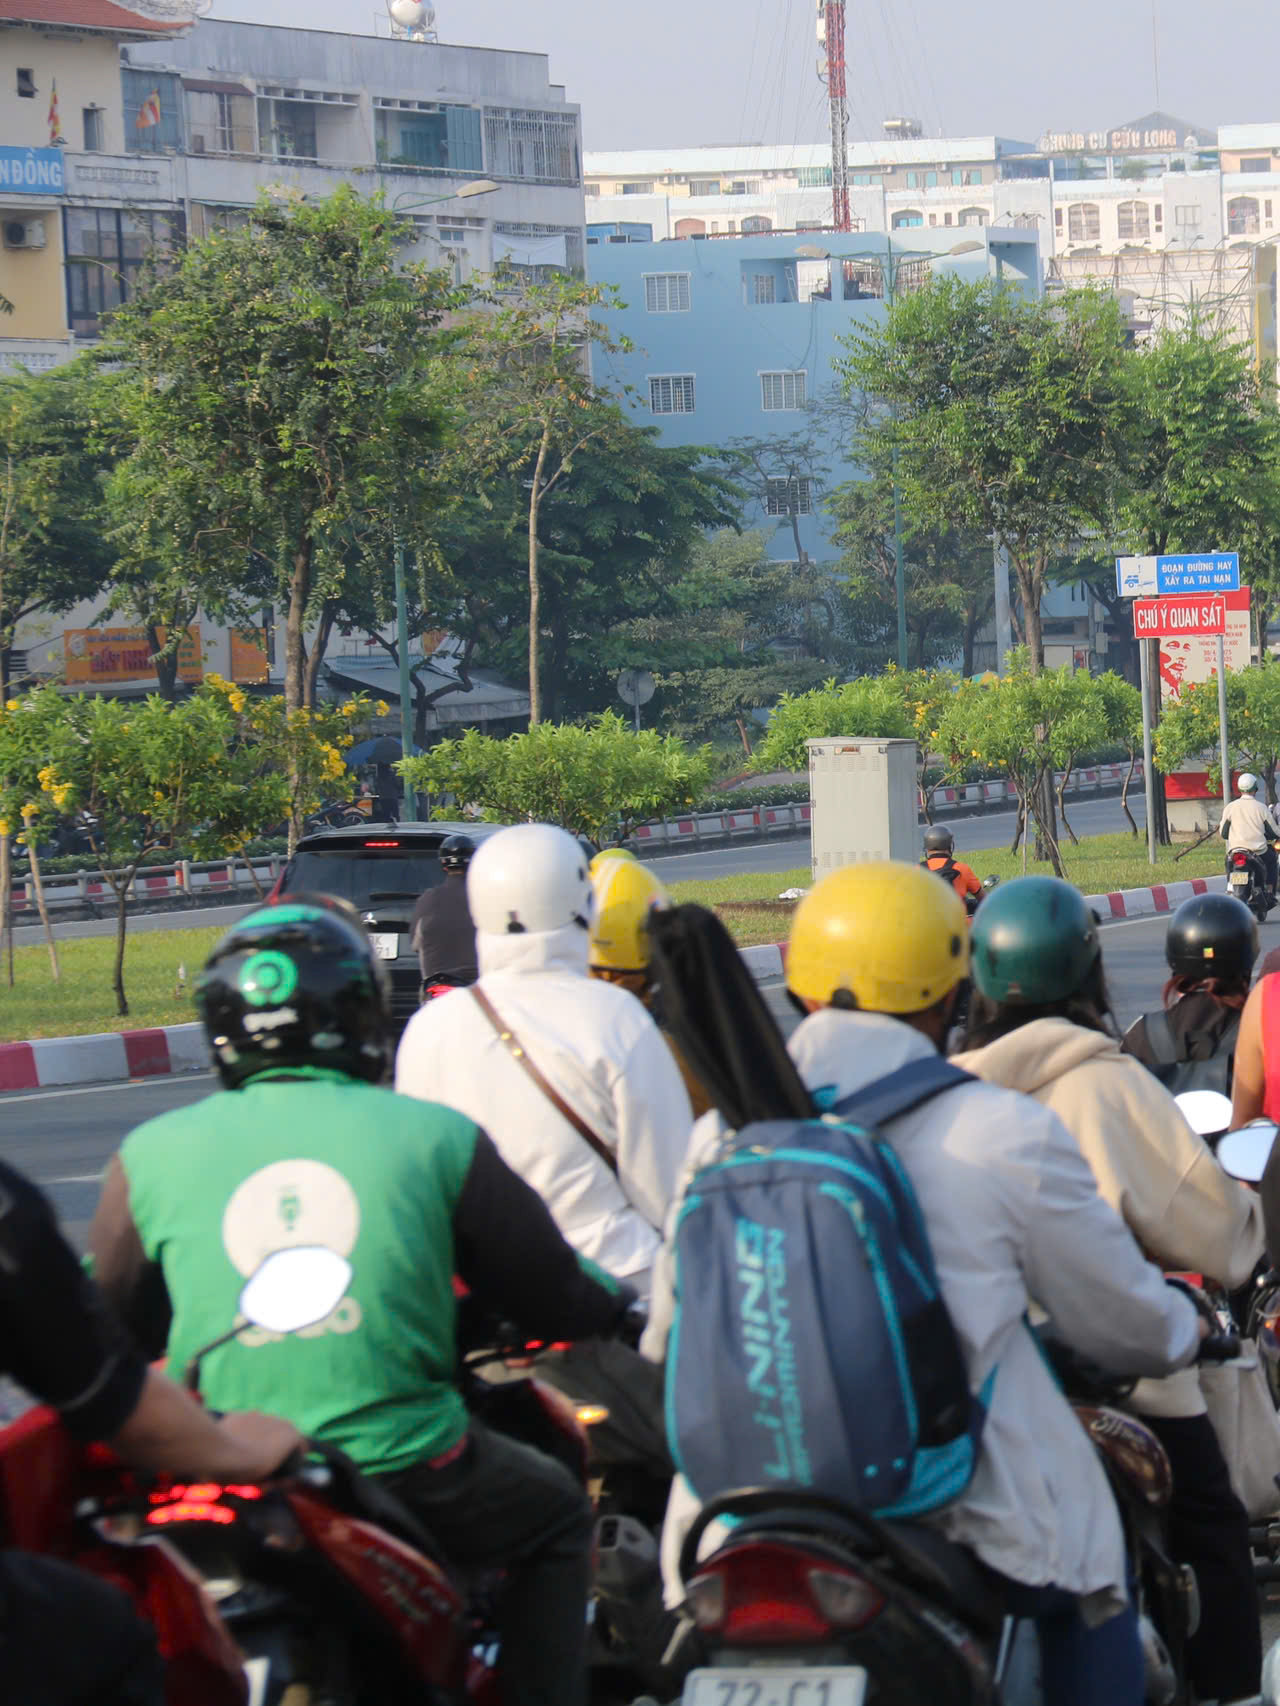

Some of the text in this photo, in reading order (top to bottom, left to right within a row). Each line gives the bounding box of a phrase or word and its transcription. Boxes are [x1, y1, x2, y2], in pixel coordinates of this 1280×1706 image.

[1039, 133, 1085, 152] CHUNG
[1144, 130, 1176, 147] LONG
[1161, 563, 1184, 574] ĐOẠN
[1217, 561, 1233, 571] HAY
[1183, 576, 1195, 585] RA
[1198, 575, 1210, 584] TAI
[1213, 574, 1231, 586] NẠN
[1137, 601, 1222, 630] CHÚ Ý QUAN SÁT
